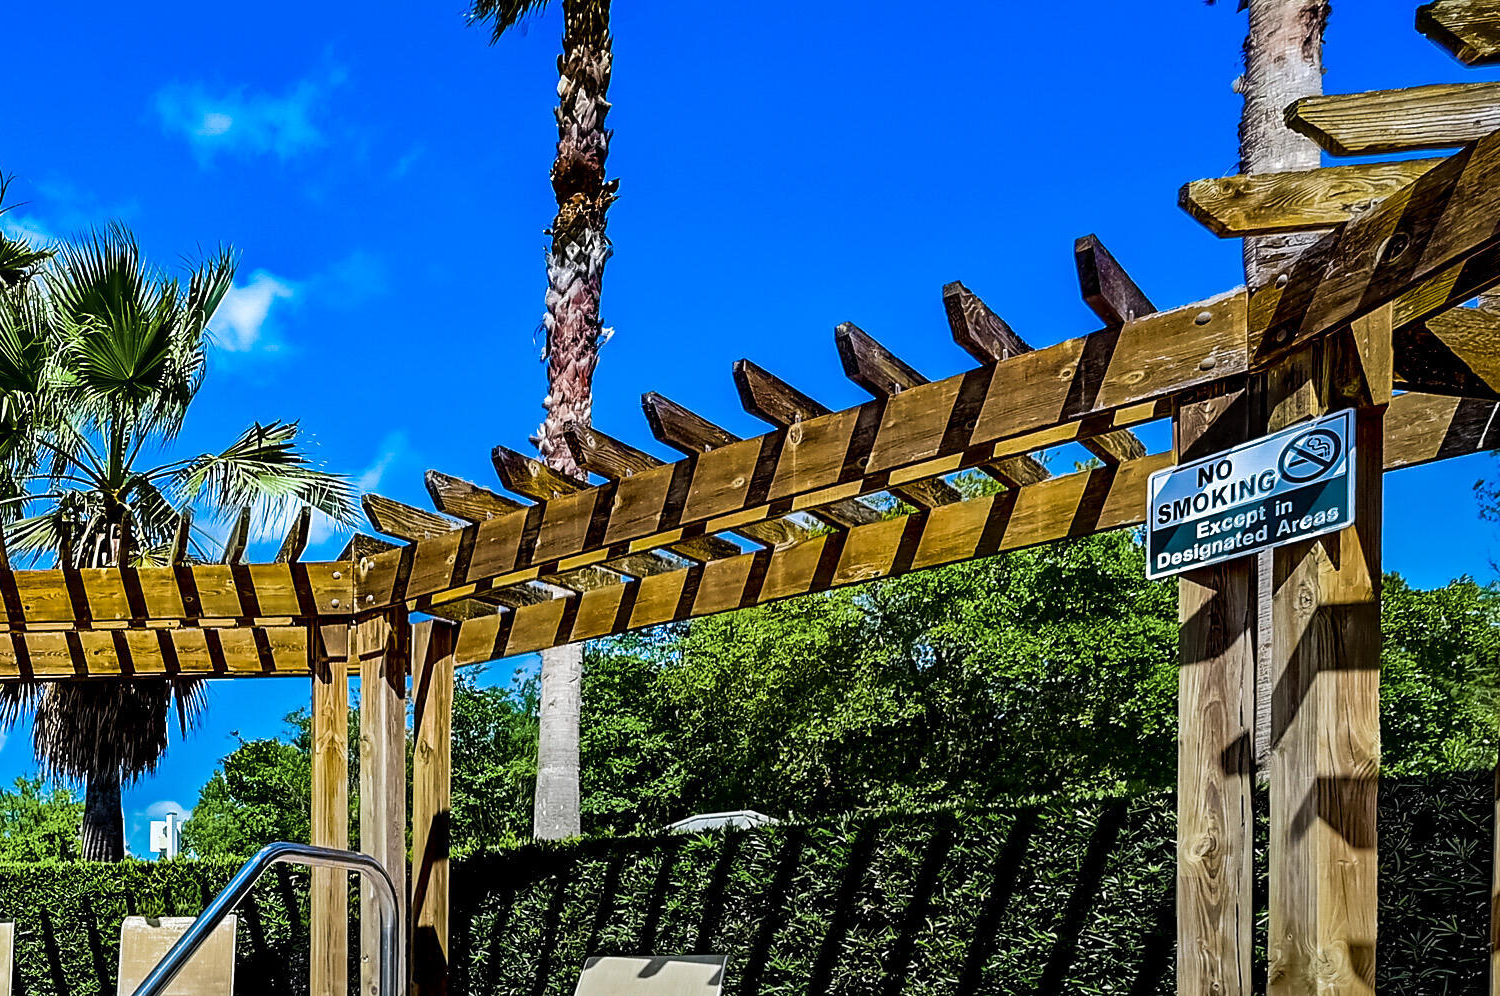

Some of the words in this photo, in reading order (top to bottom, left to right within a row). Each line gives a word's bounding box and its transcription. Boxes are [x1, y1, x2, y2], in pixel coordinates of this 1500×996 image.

[1157, 469, 1276, 525] SMOKING
[1197, 459, 1233, 488] NO
[1157, 524, 1268, 570] Designated
[1275, 506, 1339, 537] Areas
[1196, 507, 1266, 539] Except
[1275, 500, 1293, 517] in
